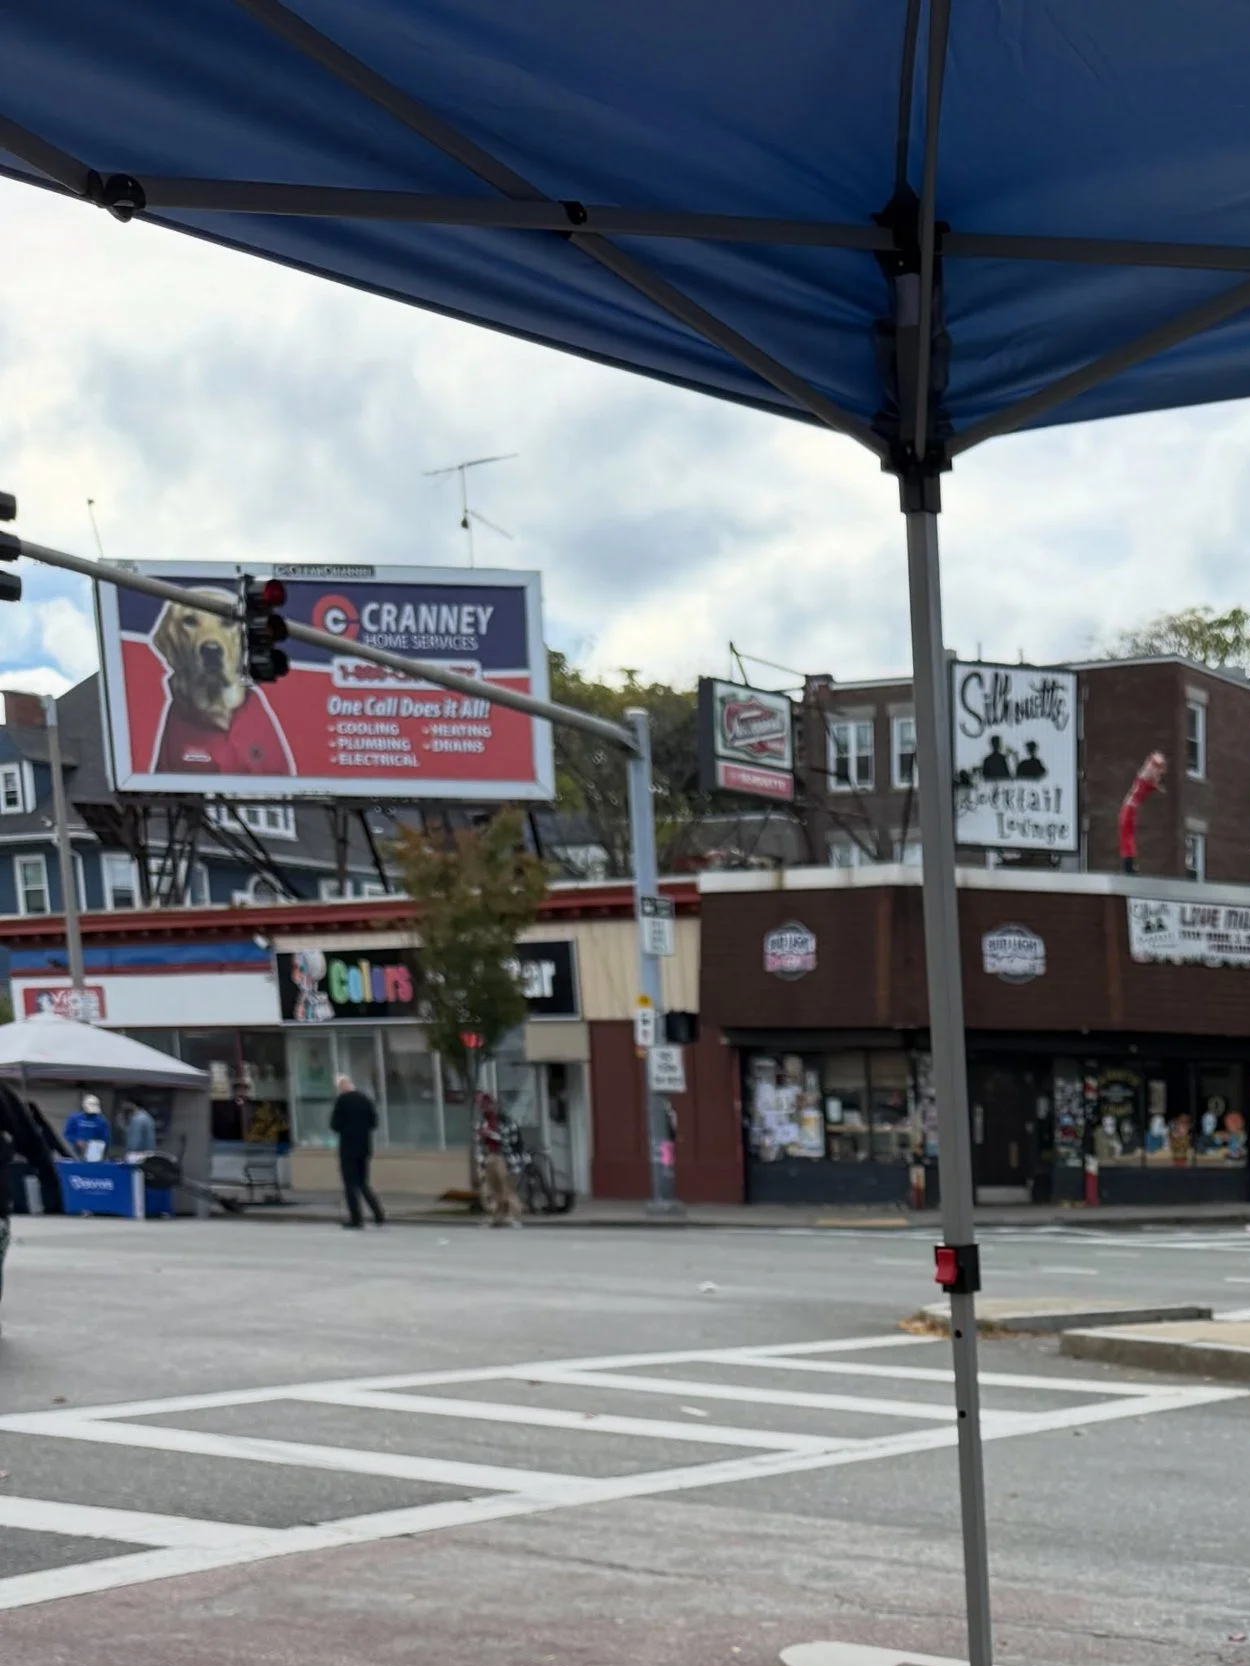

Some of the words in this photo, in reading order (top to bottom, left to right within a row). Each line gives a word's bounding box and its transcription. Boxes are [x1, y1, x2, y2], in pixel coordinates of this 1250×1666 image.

[362, 603, 494, 636] CRANNEY
[365, 634, 408, 650] HOME
[412, 635, 480, 651] SERVICES
[327, 697, 362, 716] One
[365, 697, 397, 717] Call
[400, 699, 441, 718] Does
[444, 699, 457, 719] it
[460, 699, 491, 719] All!
[960, 672, 1069, 739] Silhouette
[336, 723, 399, 735] COOLING
[431, 724, 491, 738] HEATING
[338, 738, 411, 752] PLUMBING
[431, 740, 485, 753] DRAINS
[338, 753, 420, 768] ELECTRICAL
